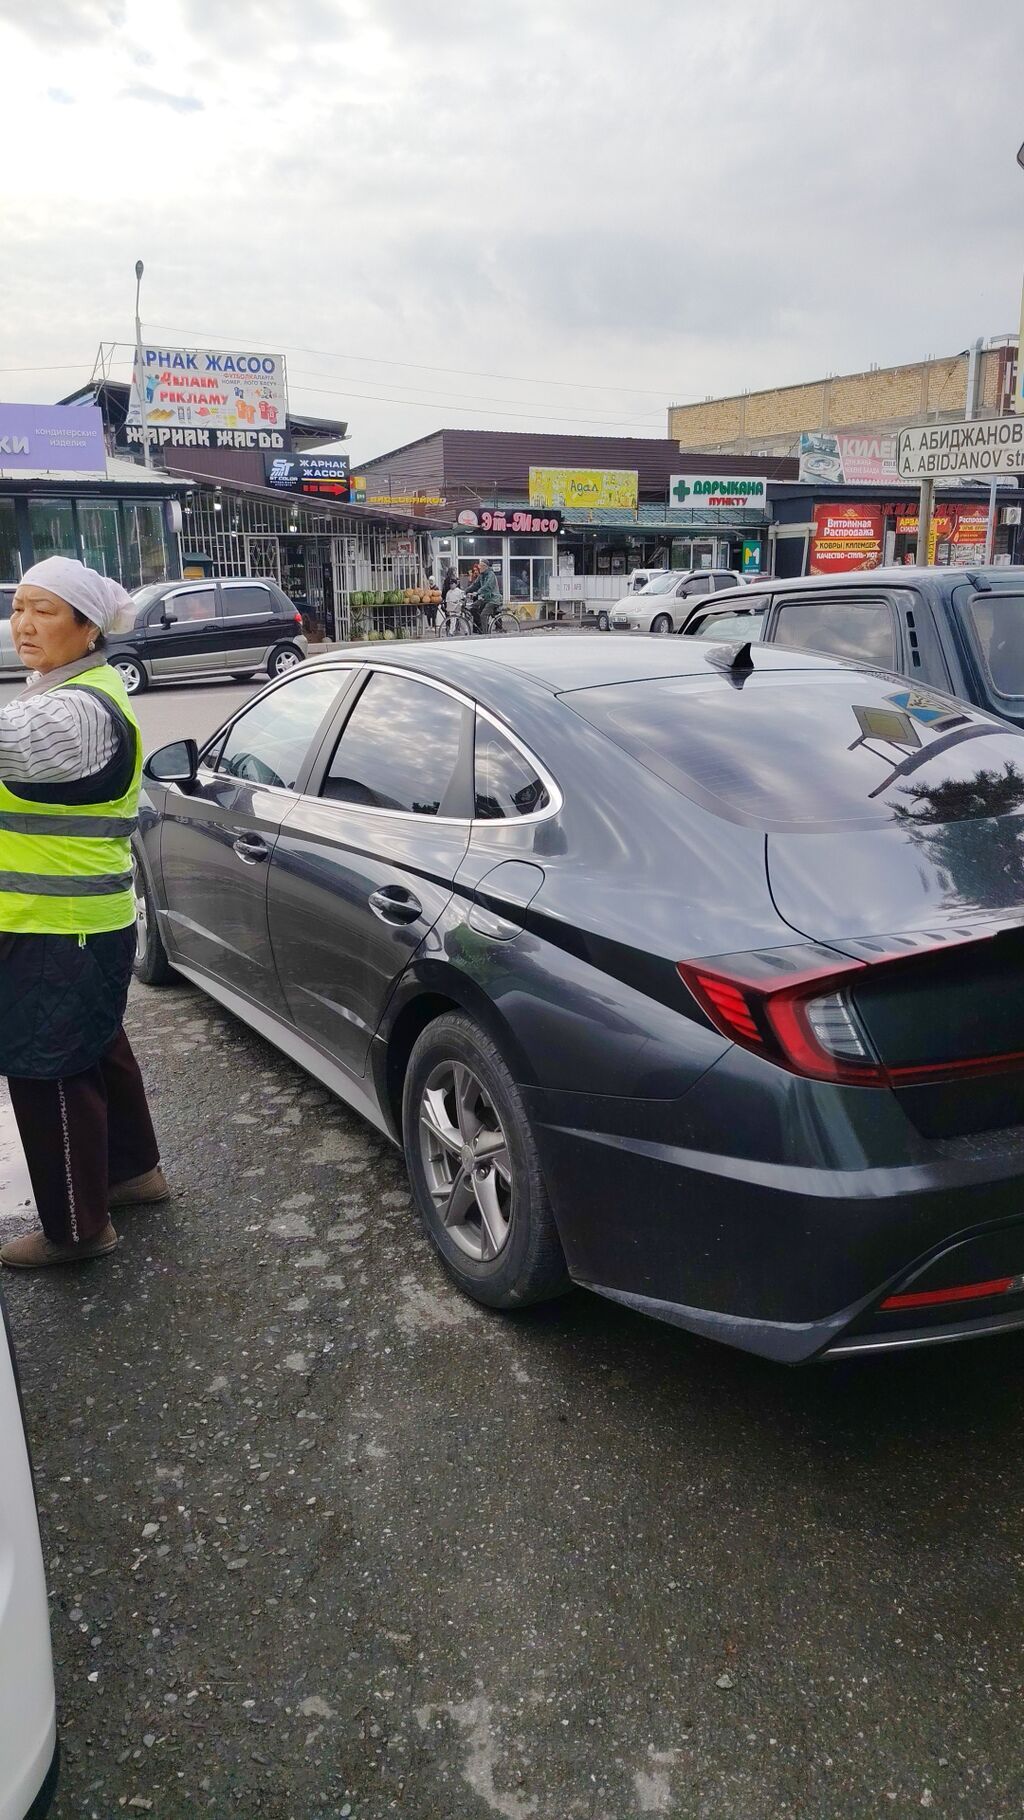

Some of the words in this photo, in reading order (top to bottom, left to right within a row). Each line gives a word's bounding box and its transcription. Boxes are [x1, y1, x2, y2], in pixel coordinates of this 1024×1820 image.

[205, 354, 275, 374] ЖАСОО
[125, 426, 210, 447] ЖАРНАК
[217, 429, 284, 448] ЖАСОО
[919, 423, 1023, 451] АБИДЖАНОВ
[299, 459, 347, 468] ЖАРНАК
[902, 457, 915, 473] A.
[917, 450, 1003, 471] ABIDJANOV
[303, 469, 345, 478] ЖАСОО
[569, 482, 599, 496] Адал
[692, 480, 764, 496] ДАРЫКАНА
[708, 497, 748, 507] ПУНКТУ
[827, 518, 872, 528] Витринная
[823, 528, 874, 537] Распродажа
